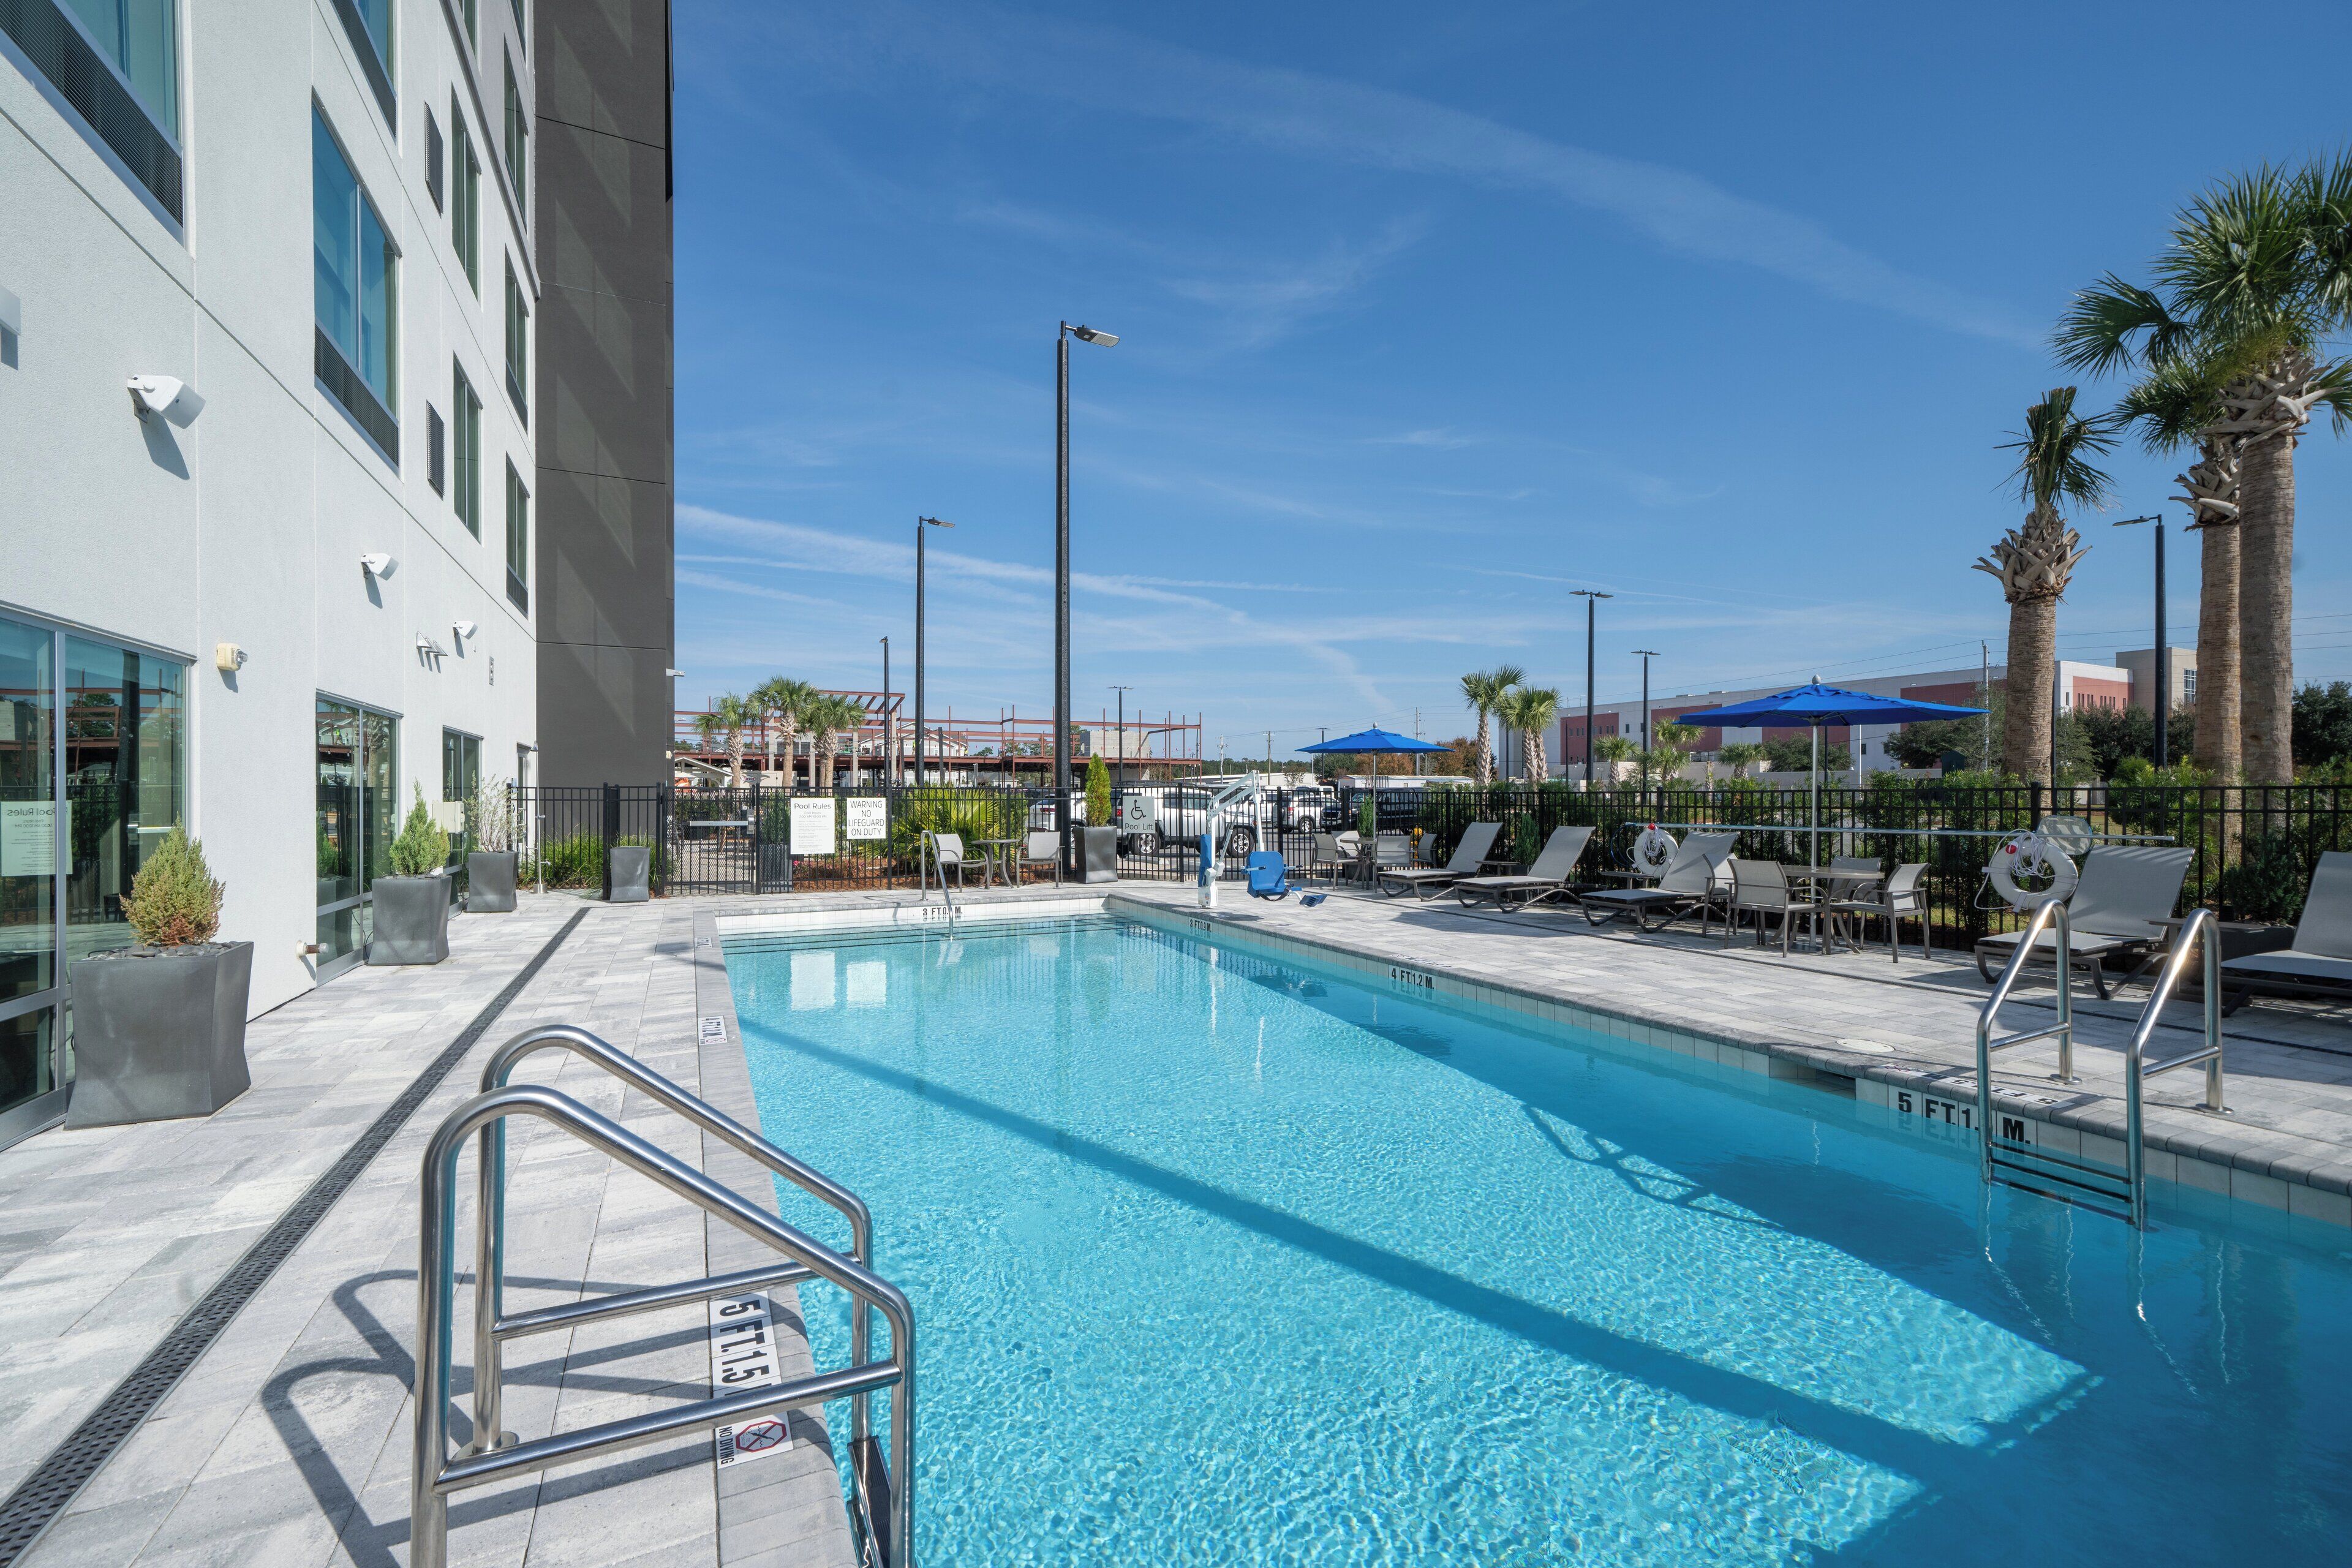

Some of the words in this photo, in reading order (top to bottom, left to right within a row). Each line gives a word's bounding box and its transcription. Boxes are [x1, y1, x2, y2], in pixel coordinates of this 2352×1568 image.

[1392, 968, 1396, 979] 4
[1425, 976, 1434, 989] M.
[1898, 1091, 1912, 1113] 5
[1961, 1108, 1978, 1131] 1.
[2003, 1117, 2030, 1144] M.
[719, 1300, 761, 1316] 5
[719, 1426, 733, 1438] NO
[719, 1438, 734, 1465] DIVING
